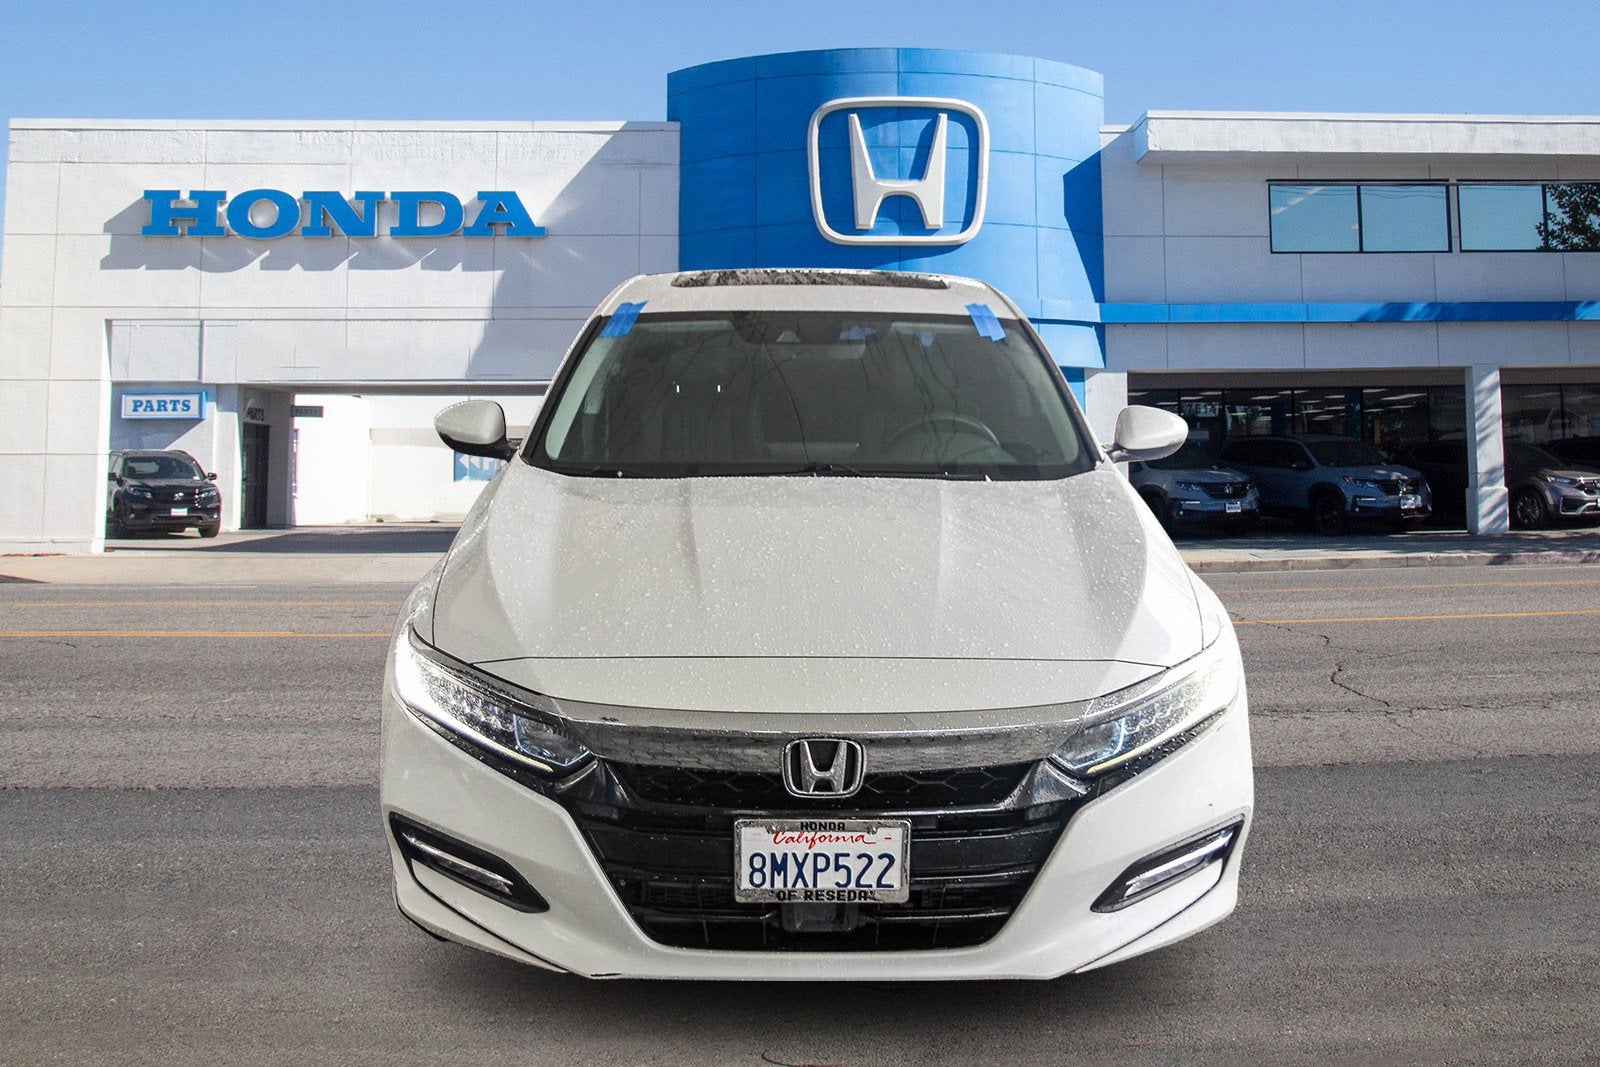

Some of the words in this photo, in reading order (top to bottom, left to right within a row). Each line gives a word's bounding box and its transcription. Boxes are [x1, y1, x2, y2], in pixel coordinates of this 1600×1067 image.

[141, 188, 548, 239] HONDA
[132, 399, 191, 412] PARTS
[800, 821, 846, 831] HONDA
[772, 830, 876, 850] California
[748, 852, 896, 889] 8MXP522
